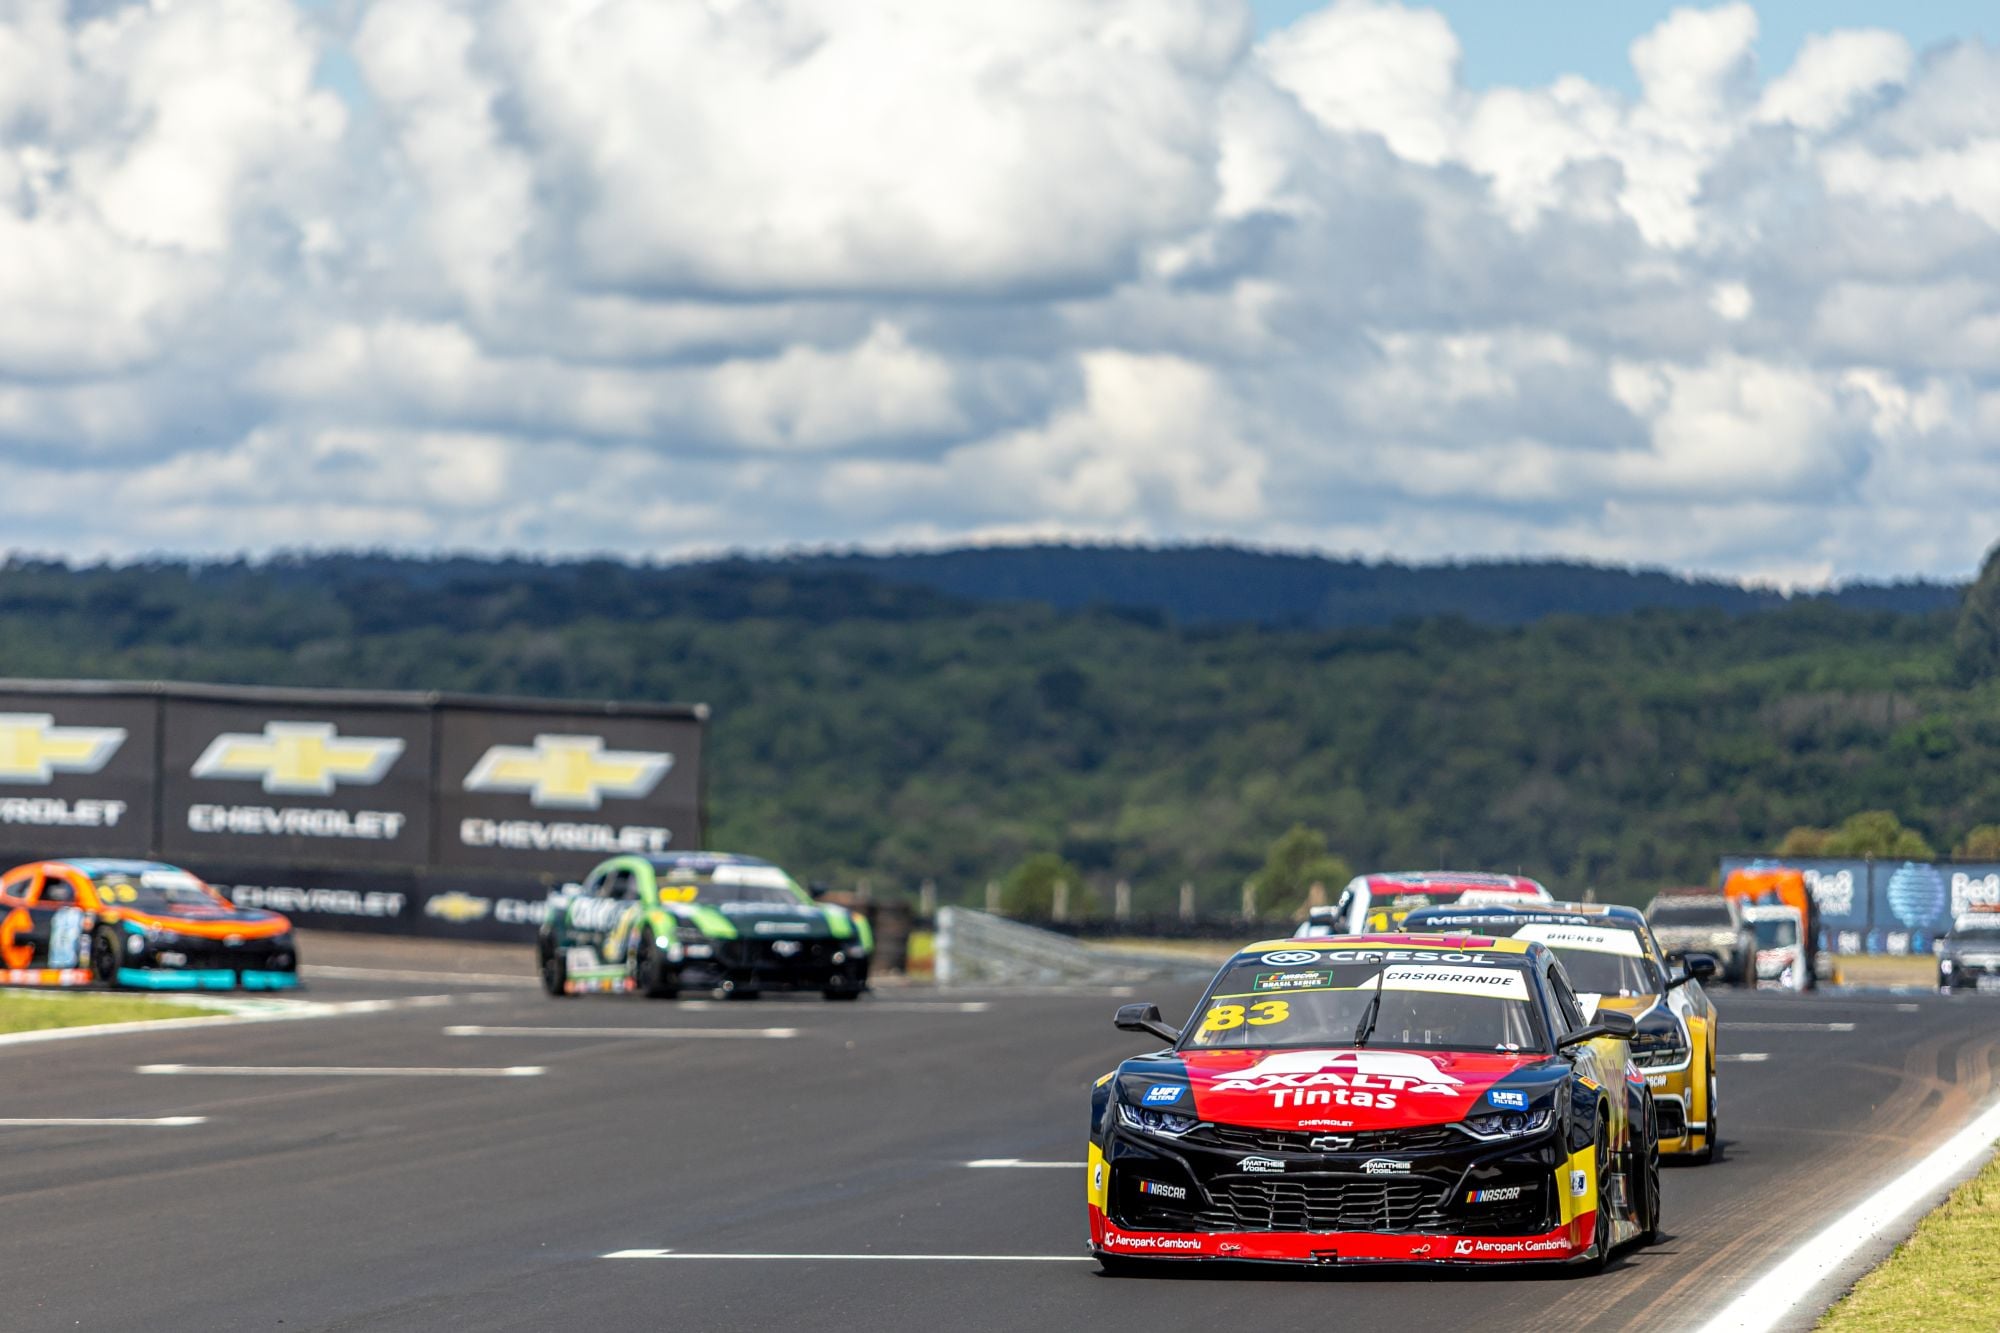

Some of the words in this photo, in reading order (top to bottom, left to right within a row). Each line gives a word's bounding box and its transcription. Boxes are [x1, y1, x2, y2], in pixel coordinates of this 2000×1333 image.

[187, 804, 404, 839] CHEVROLET
[460, 818, 672, 852] CHEVROLET
[232, 885, 404, 916] CHEVROLET
[1328, 950, 1496, 964] CRESOL
[1386, 971, 1514, 987] CASAGRANDE
[1205, 1001, 1289, 1030] 83
[1210, 1073, 1460, 1096] AXALTA
[1268, 1087, 1396, 1109] Tintas
[1298, 1119, 1353, 1127] CHEVROLET
[1150, 1183, 1186, 1200] NASCAR
[1480, 1187, 1520, 1202] NASCAR
[1115, 1234, 1156, 1248] Aeropark
[1475, 1240, 1523, 1253] Aeropark
